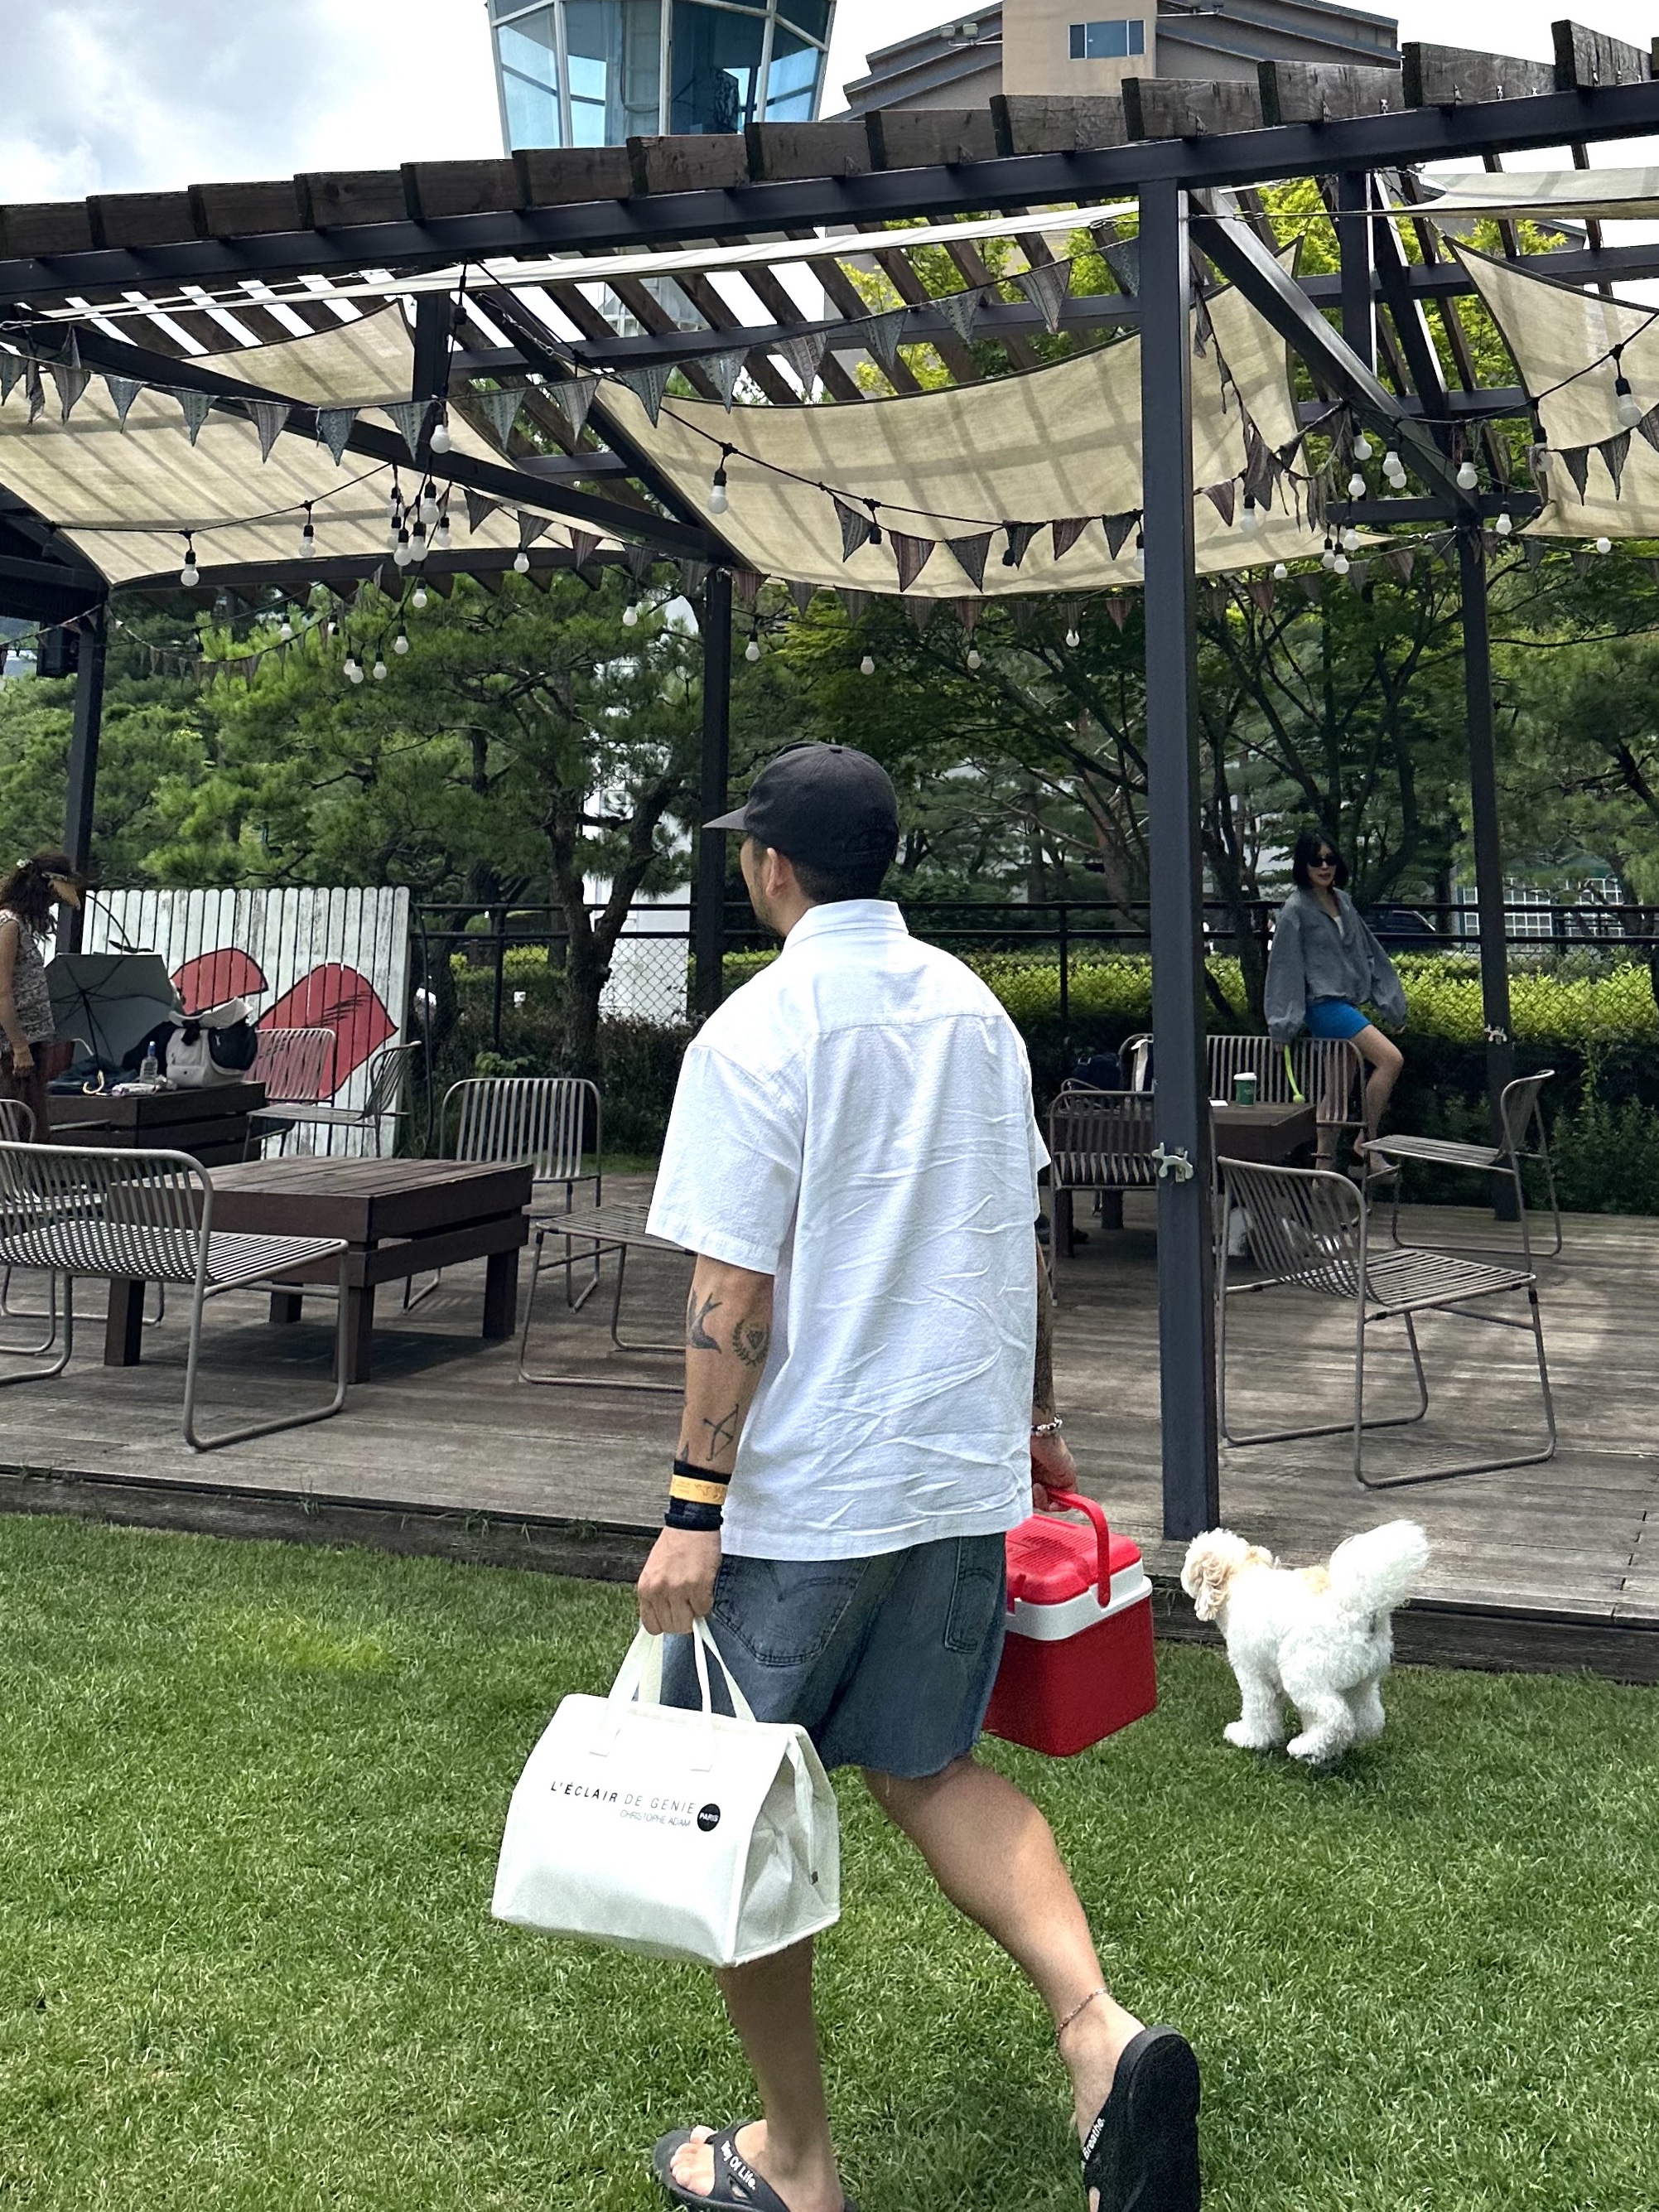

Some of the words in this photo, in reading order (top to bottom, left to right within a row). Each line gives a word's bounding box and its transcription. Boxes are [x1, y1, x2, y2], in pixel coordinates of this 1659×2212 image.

[550, 1780, 619, 1804] L'ÉCLAIR
[624, 1793, 644, 1807] DE
[668, 1816, 692, 1828] ADAM
[698, 1811, 720, 1823] PARIS
[729, 2156, 743, 2171] Of
[737, 2166, 756, 2190] Life.
